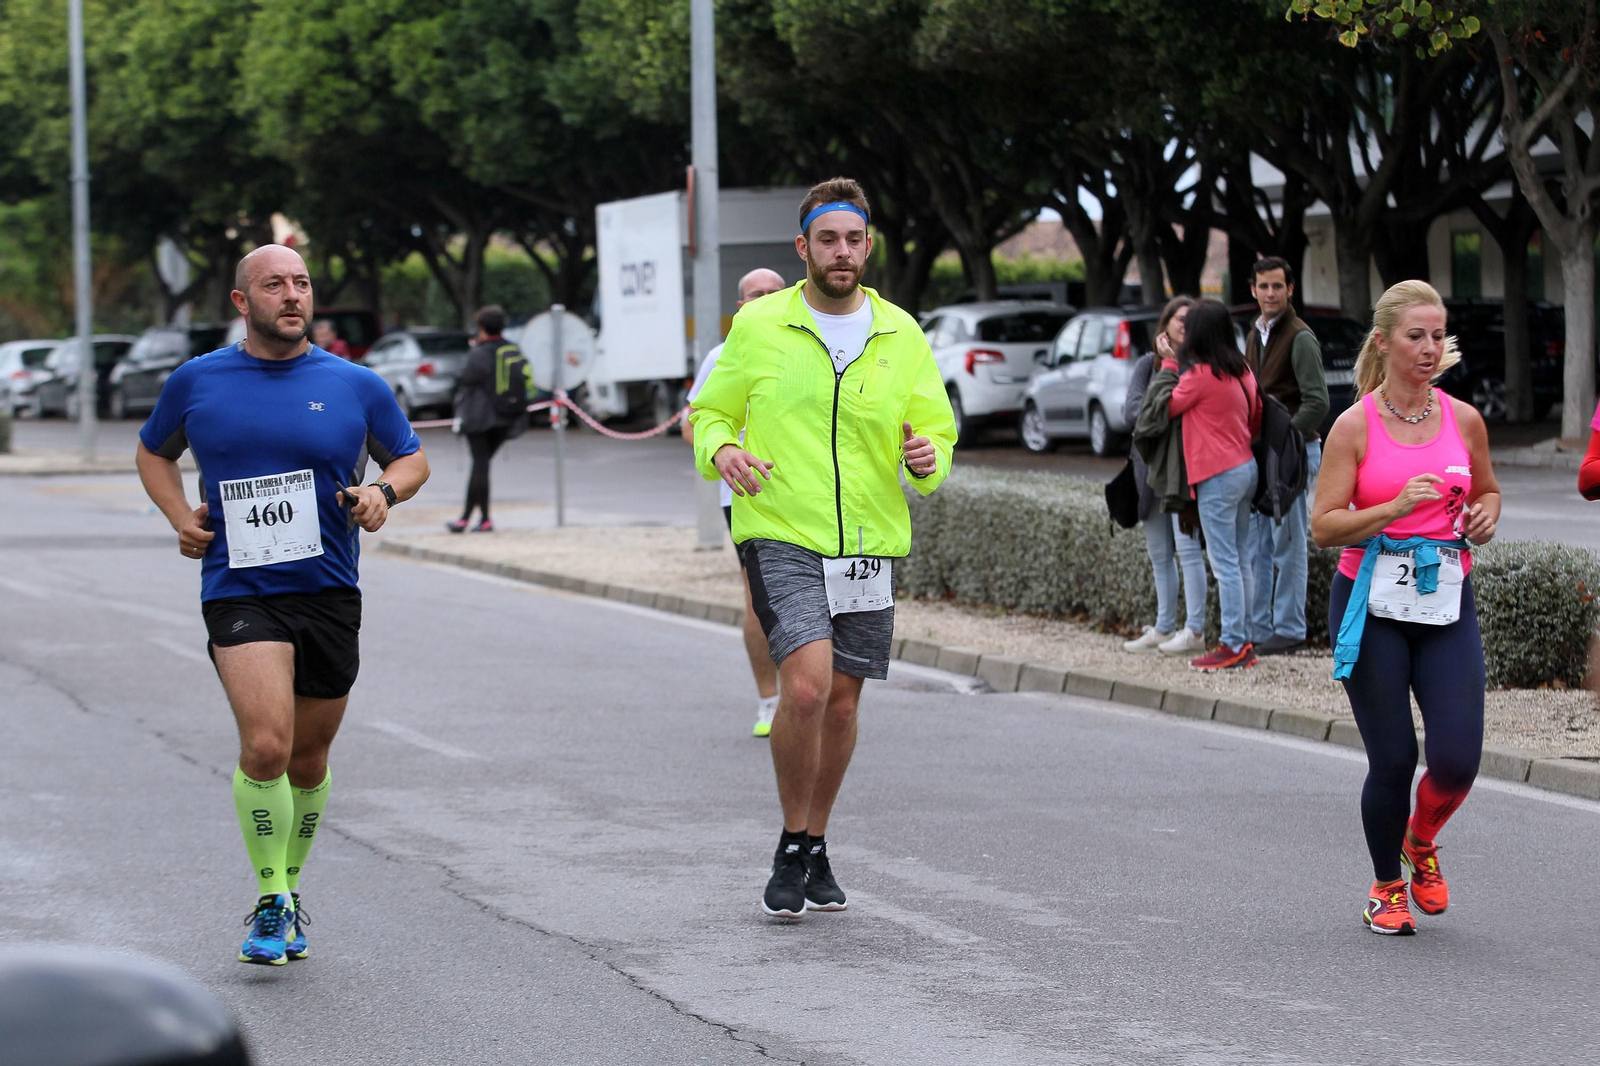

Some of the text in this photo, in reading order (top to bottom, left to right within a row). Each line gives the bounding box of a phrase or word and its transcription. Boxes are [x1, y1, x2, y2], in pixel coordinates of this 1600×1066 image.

[255, 472, 312, 490] CARRERA POPULAR
[256, 481, 313, 498] CIUDAD DE JEREZ
[246, 500, 294, 528] 460
[844, 558, 881, 580] 429
